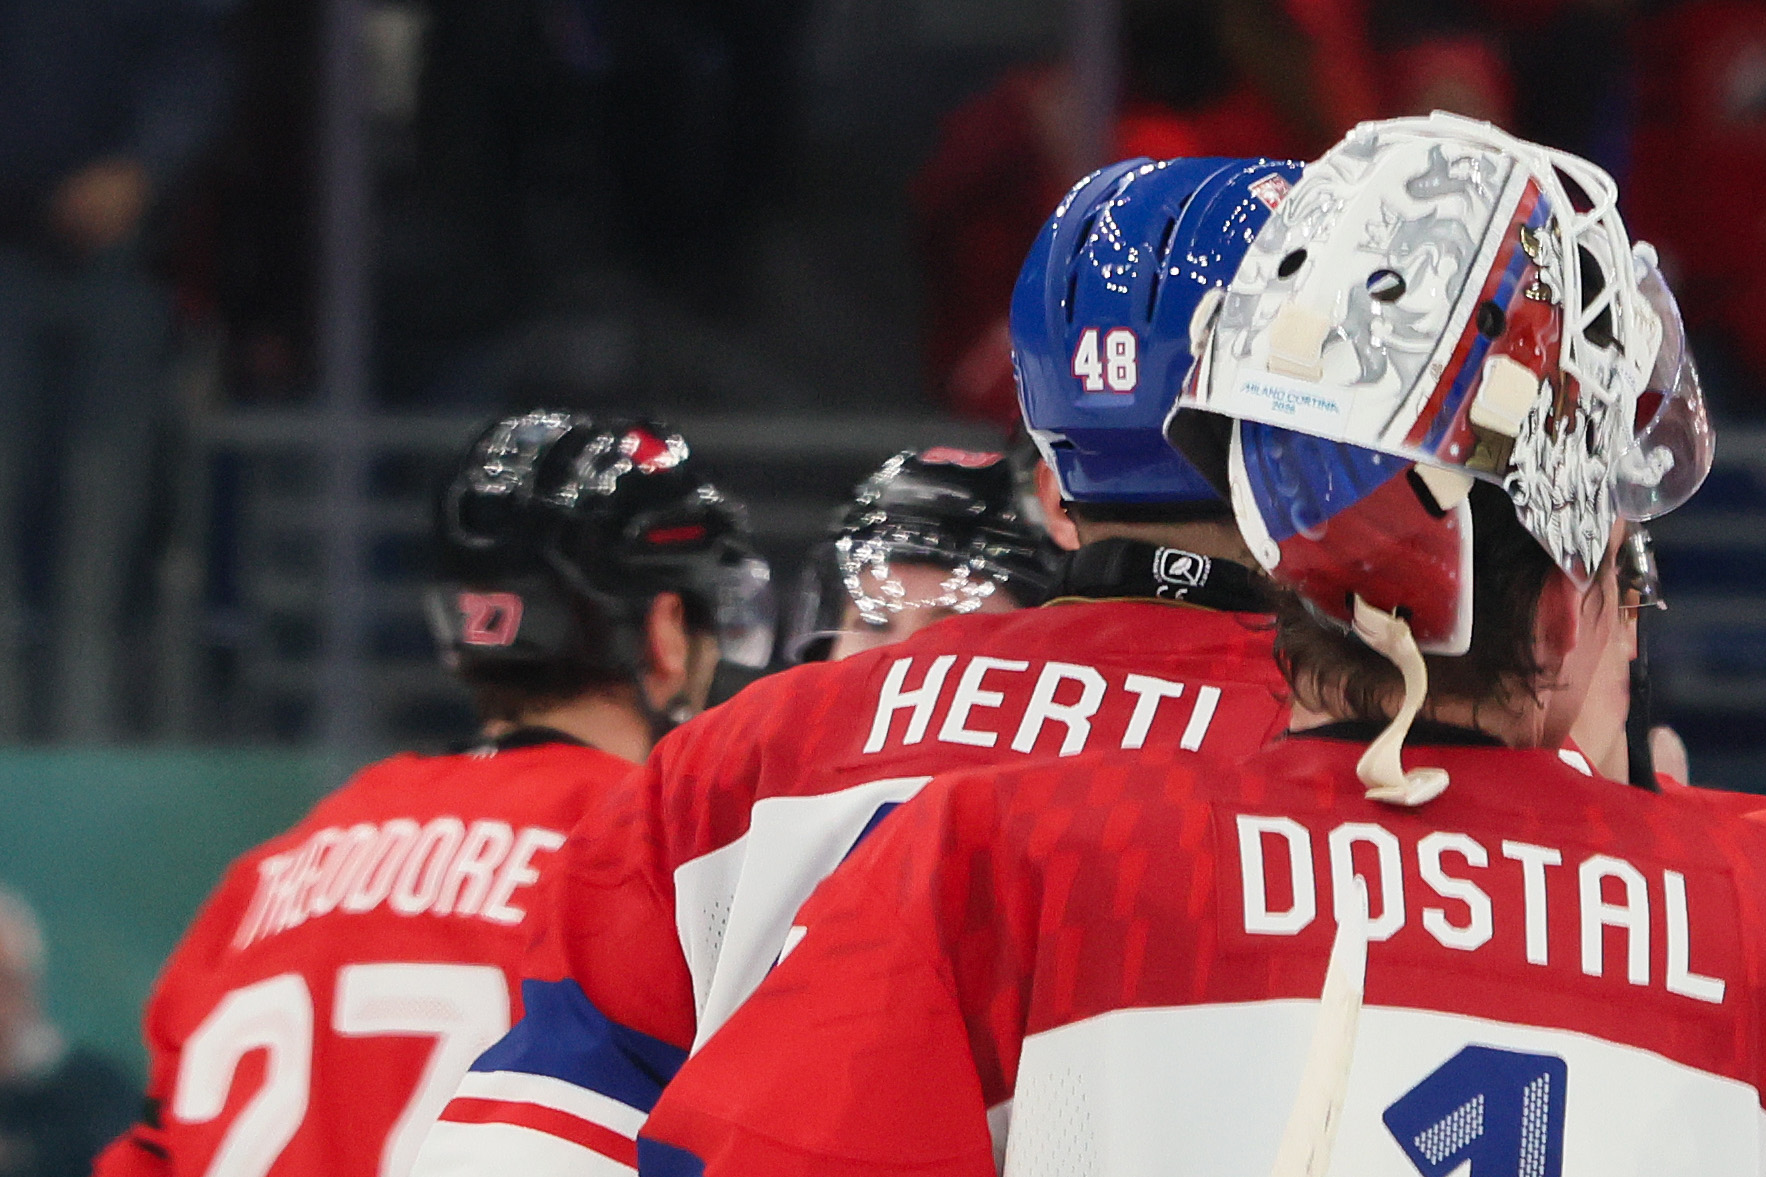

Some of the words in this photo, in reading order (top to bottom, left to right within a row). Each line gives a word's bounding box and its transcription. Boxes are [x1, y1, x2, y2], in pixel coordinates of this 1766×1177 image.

[1072, 327, 1140, 394] 48
[232, 816, 567, 953] THEODORE
[1236, 813, 1727, 1005] DOSTAL
